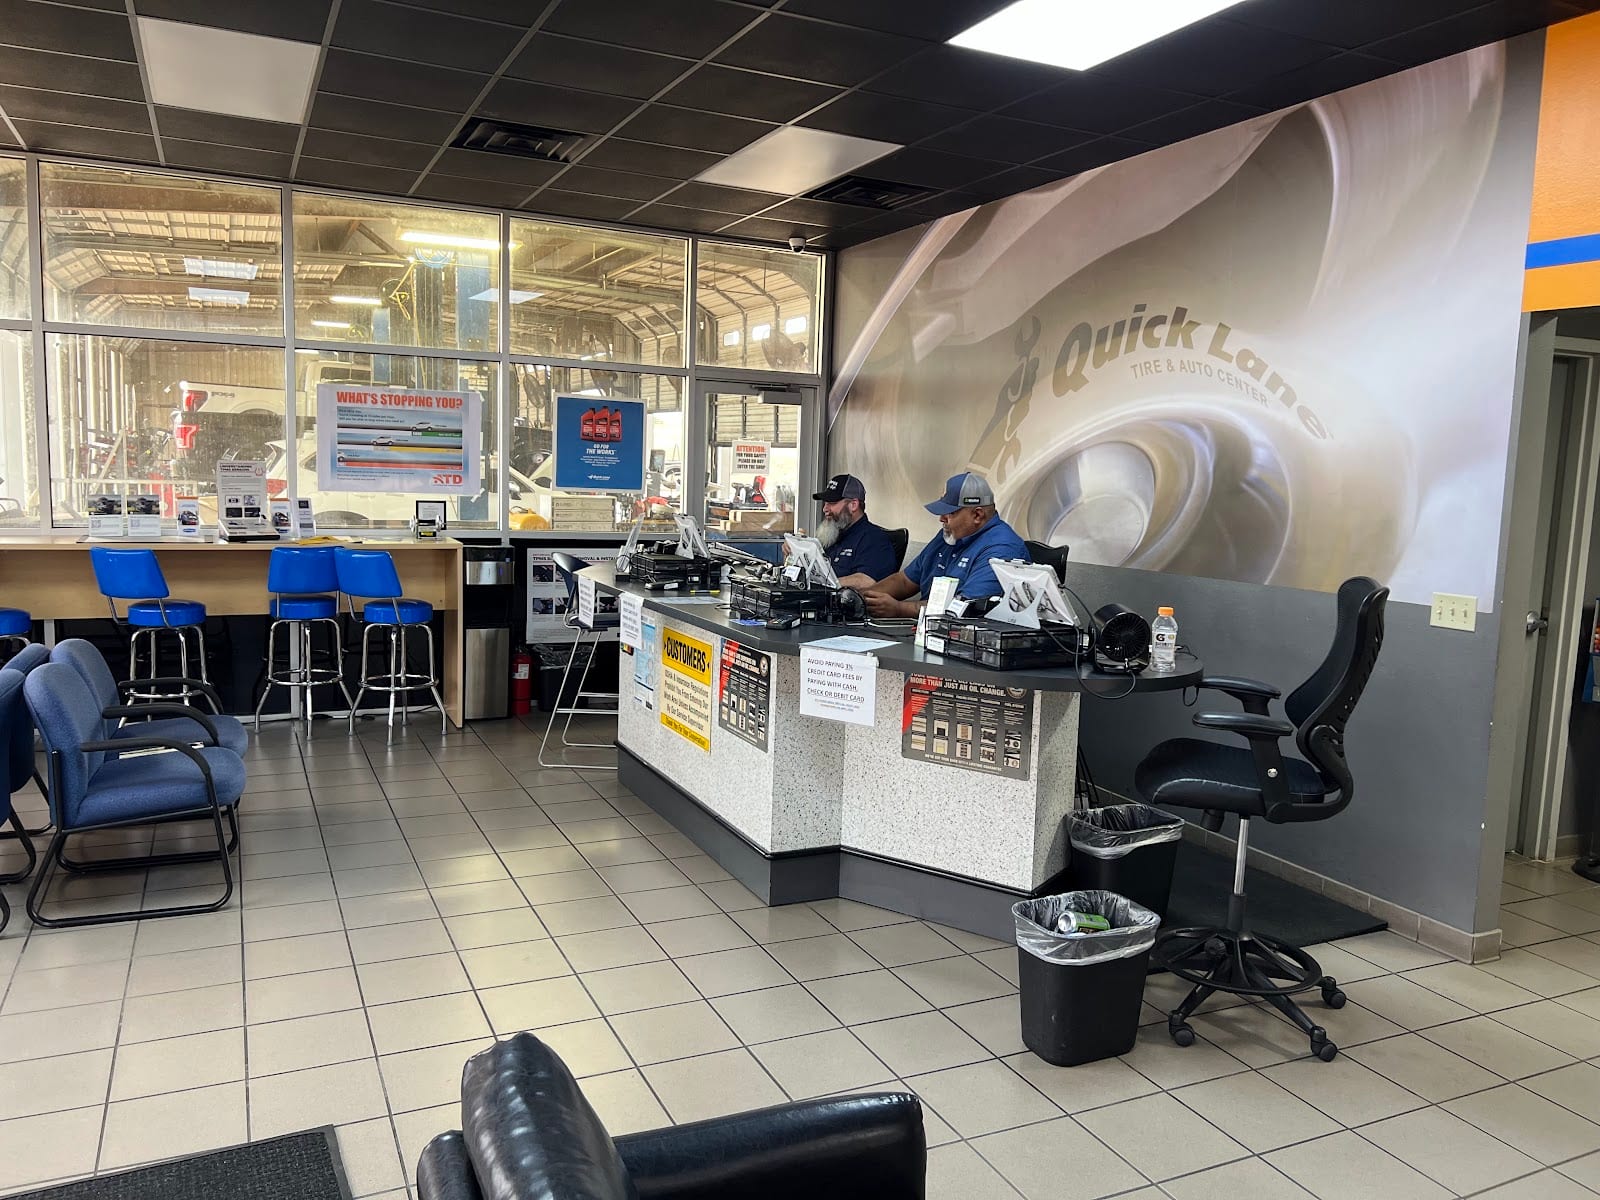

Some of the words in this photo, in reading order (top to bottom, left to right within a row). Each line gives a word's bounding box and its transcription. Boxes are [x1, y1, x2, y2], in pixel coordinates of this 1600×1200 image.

[1052, 304, 1201, 398] Quick
[1207, 322, 1327, 440] Lane
[1130, 360, 1162, 379] TIRE
[1166, 359, 1175, 372] &
[1179, 359, 1213, 378] AUTO
[1217, 368, 1269, 408] CENTER
[336, 392, 378, 405] WHAT'S
[380, 394, 432, 408] STOPPING
[435, 396, 462, 409] YOU?
[1156, 634, 1165, 642] G
[666, 637, 706, 673] CUSTOMERS
[808, 658, 824, 666] AVOID
[825, 661, 844, 669] PAYING
[807, 678, 825, 686] PAYING
[910, 677, 926, 685] MORE
[927, 678, 942, 687] THAN
[944, 680, 958, 690] JUST
[959, 683, 968, 691] AN
[969, 685, 979, 693] OIL
[980, 686, 1006, 697] CHANGE.
[807, 688, 823, 696] CHECK
[850, 694, 864, 702] CARD
